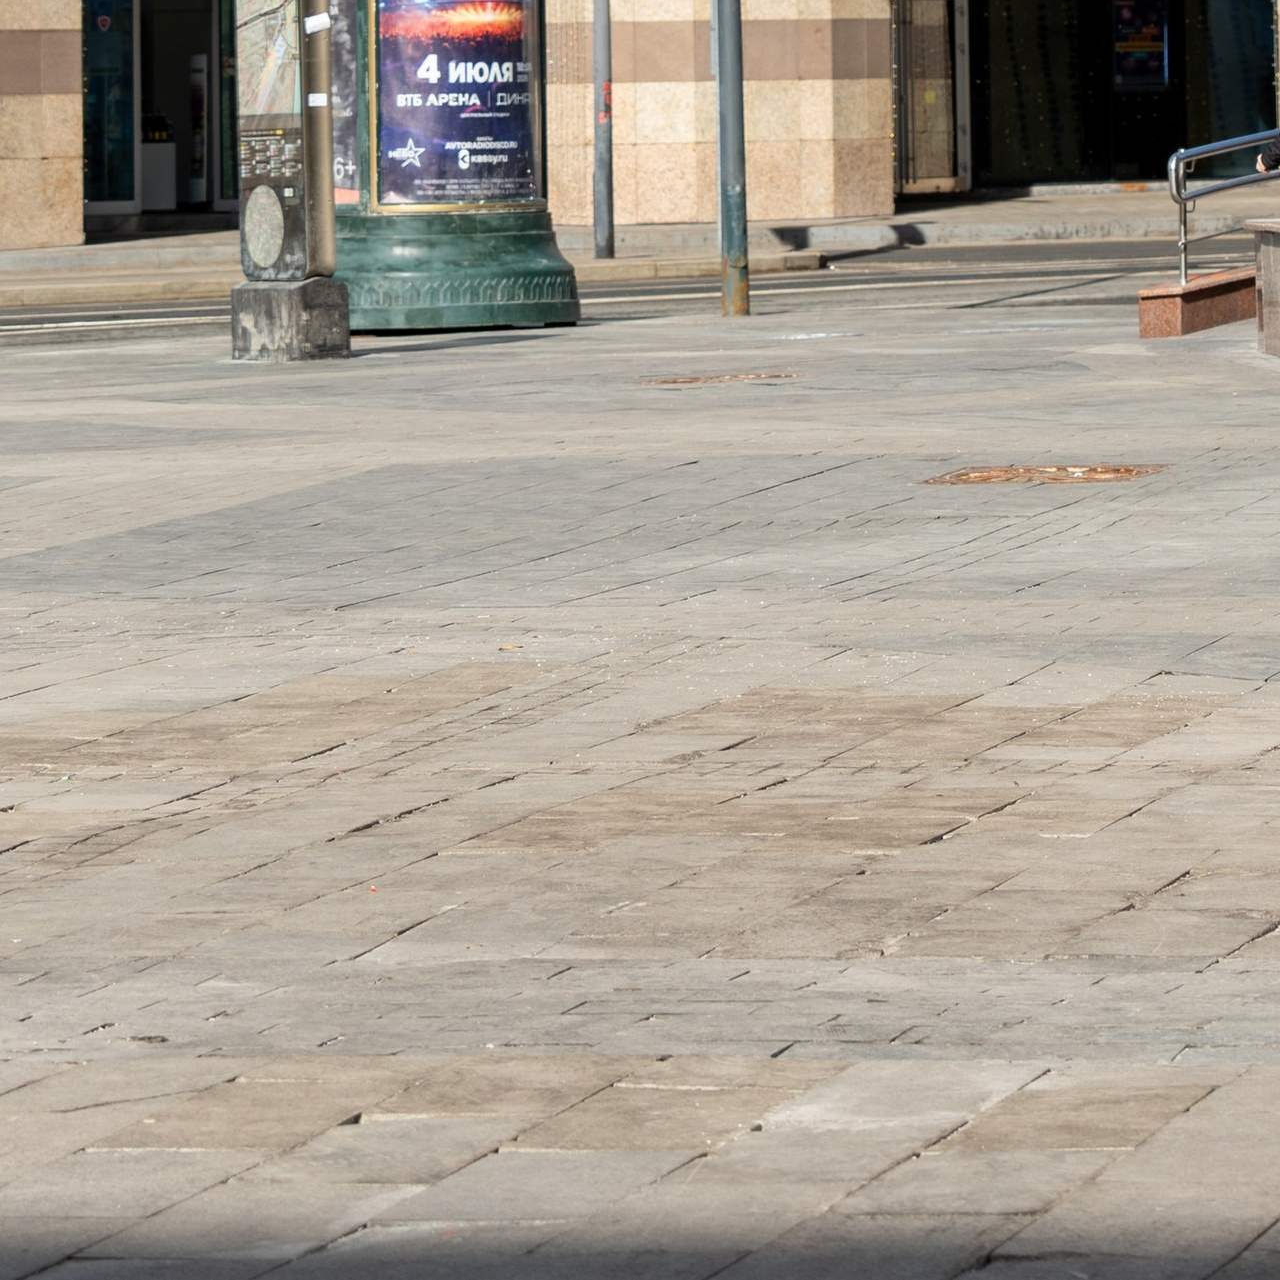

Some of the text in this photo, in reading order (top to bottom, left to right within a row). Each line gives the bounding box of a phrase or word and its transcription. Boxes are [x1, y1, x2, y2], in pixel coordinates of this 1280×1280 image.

[416, 53, 441, 84] 4
[448, 61, 514, 84] ИЮЛЯ
[396, 93, 423, 108] ВТБ
[425, 92, 481, 107] АРЕНА
